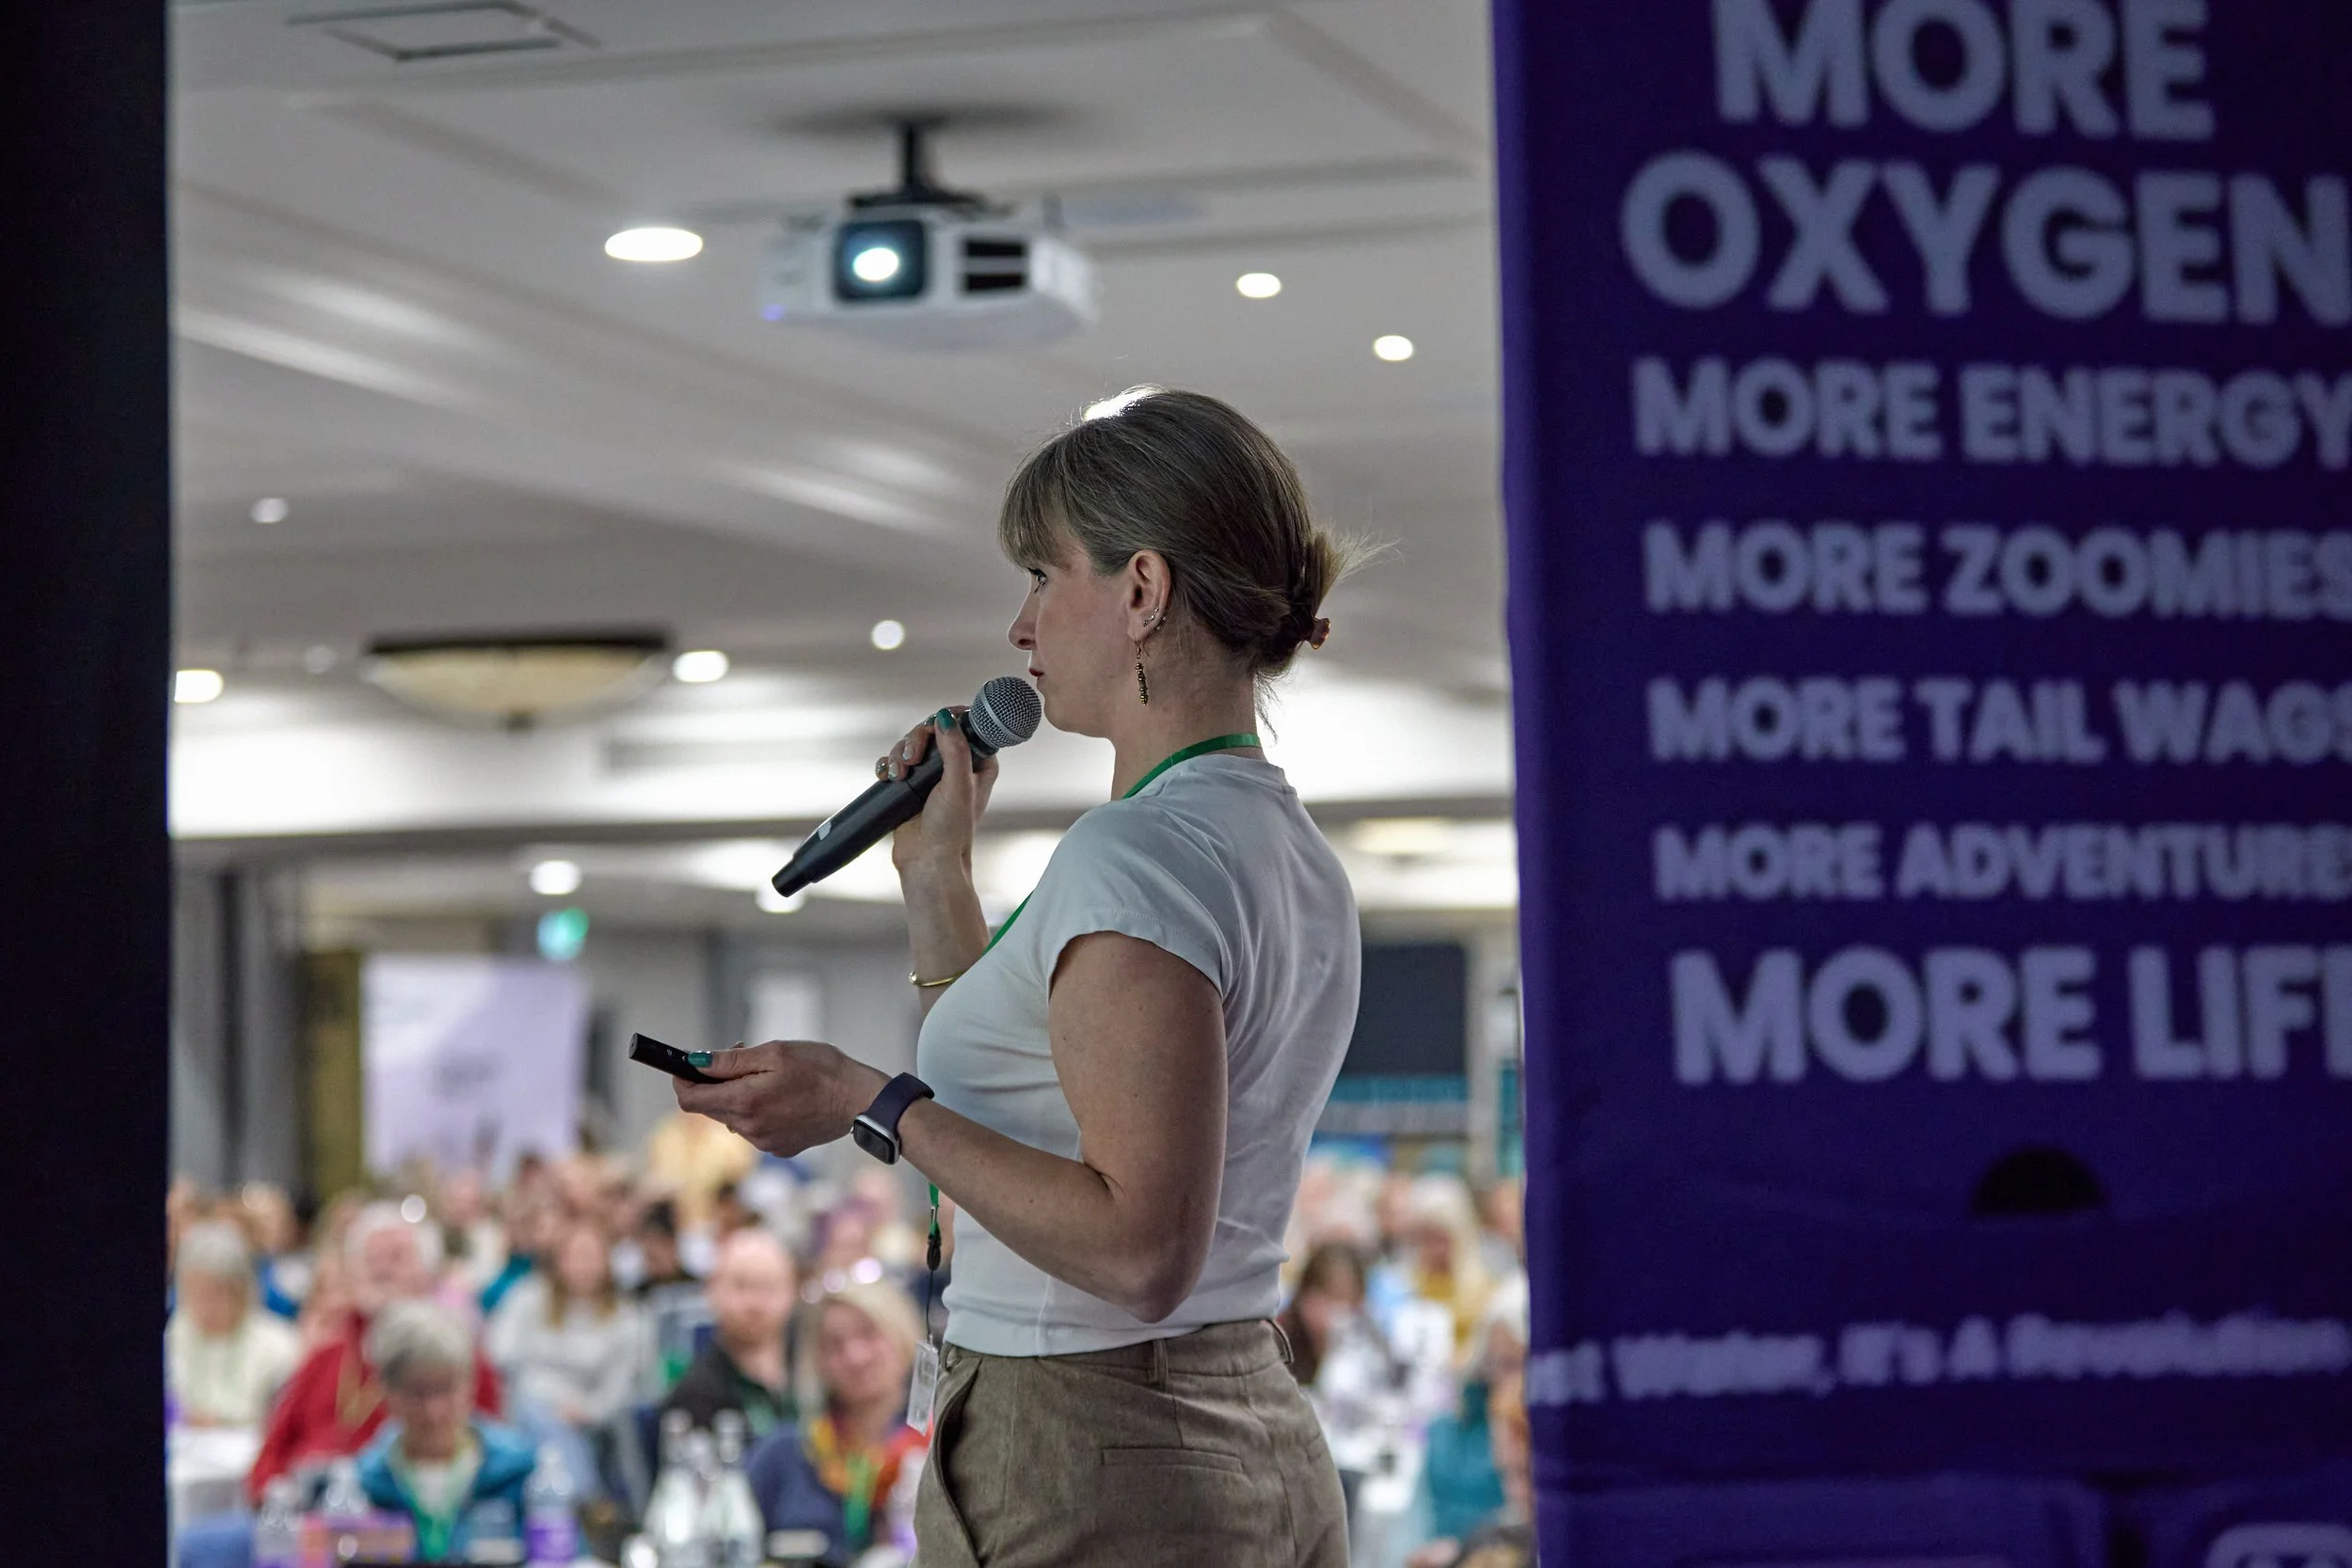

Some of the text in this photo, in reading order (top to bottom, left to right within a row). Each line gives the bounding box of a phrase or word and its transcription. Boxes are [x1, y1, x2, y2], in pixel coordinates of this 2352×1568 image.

[1710, 0, 2217, 141] MORE
[1621, 150, 2352, 325] OXYGEN
[1630, 356, 2352, 469] MORE ENERGY
[1643, 520, 2352, 620] MORE ZOOMIES
[1646, 676, 1905, 762] MORE
[1915, 679, 2106, 762] TAIL
[1653, 825, 1882, 901] MORE
[1671, 947, 2101, 1085] MORE
